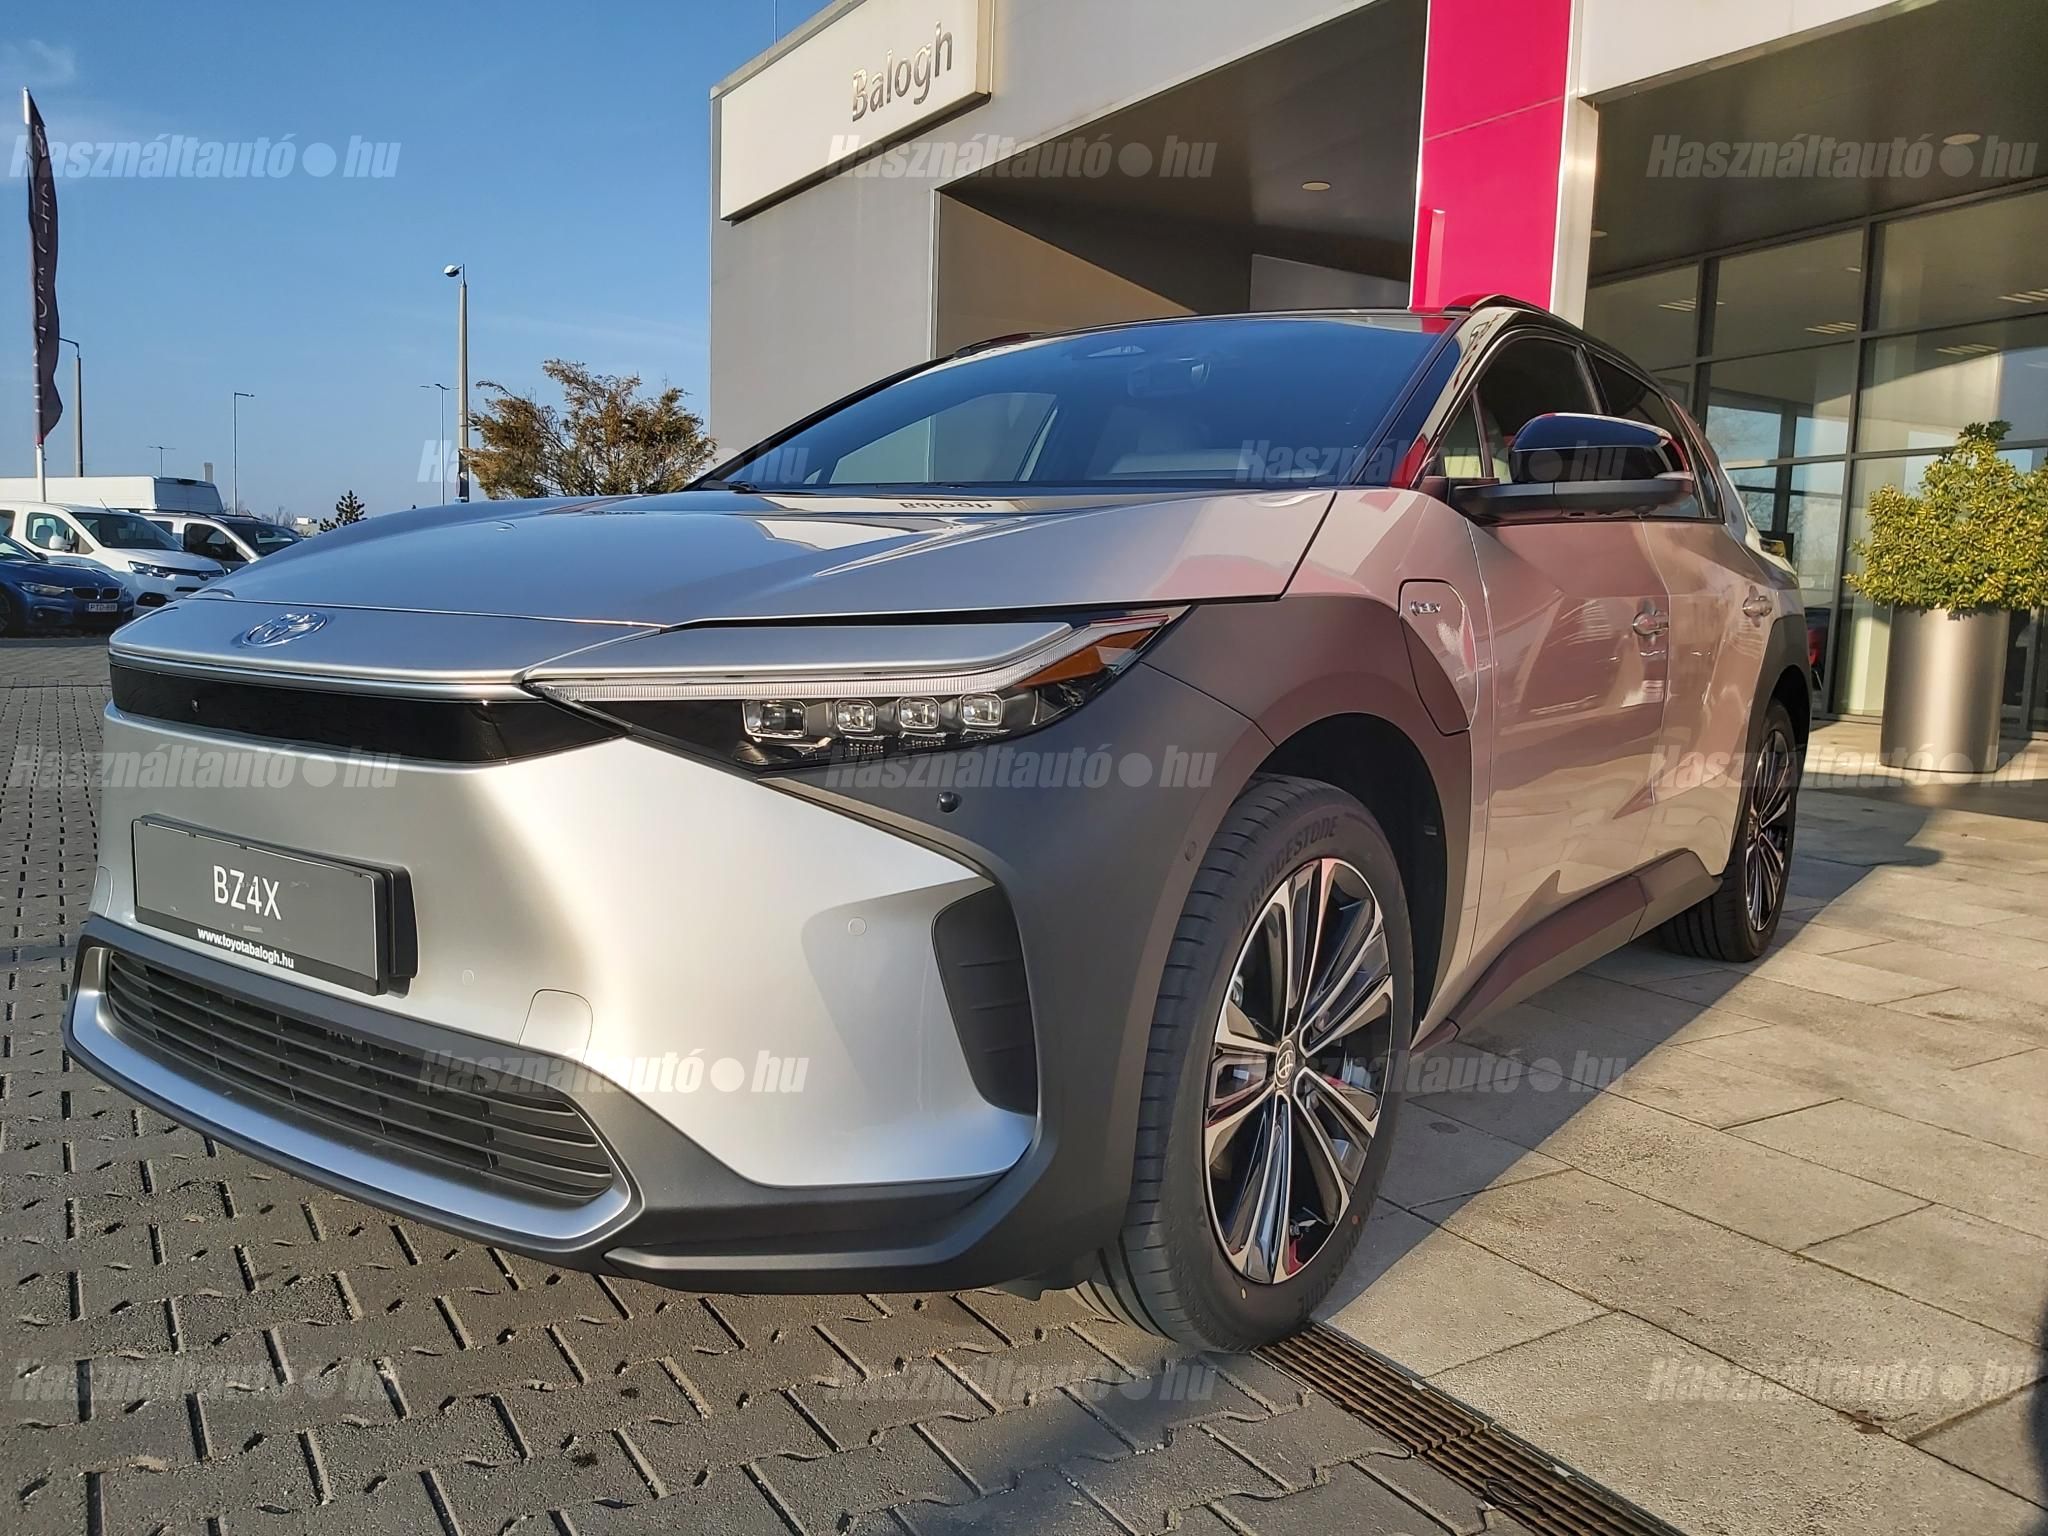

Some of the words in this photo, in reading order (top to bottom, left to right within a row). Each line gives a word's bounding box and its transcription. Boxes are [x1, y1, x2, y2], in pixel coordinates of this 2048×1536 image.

[853, 20, 953, 122] Balogh
[212, 864, 282, 921] BZ4X
[197, 927, 295, 969] www.toyotabalogh.hu
